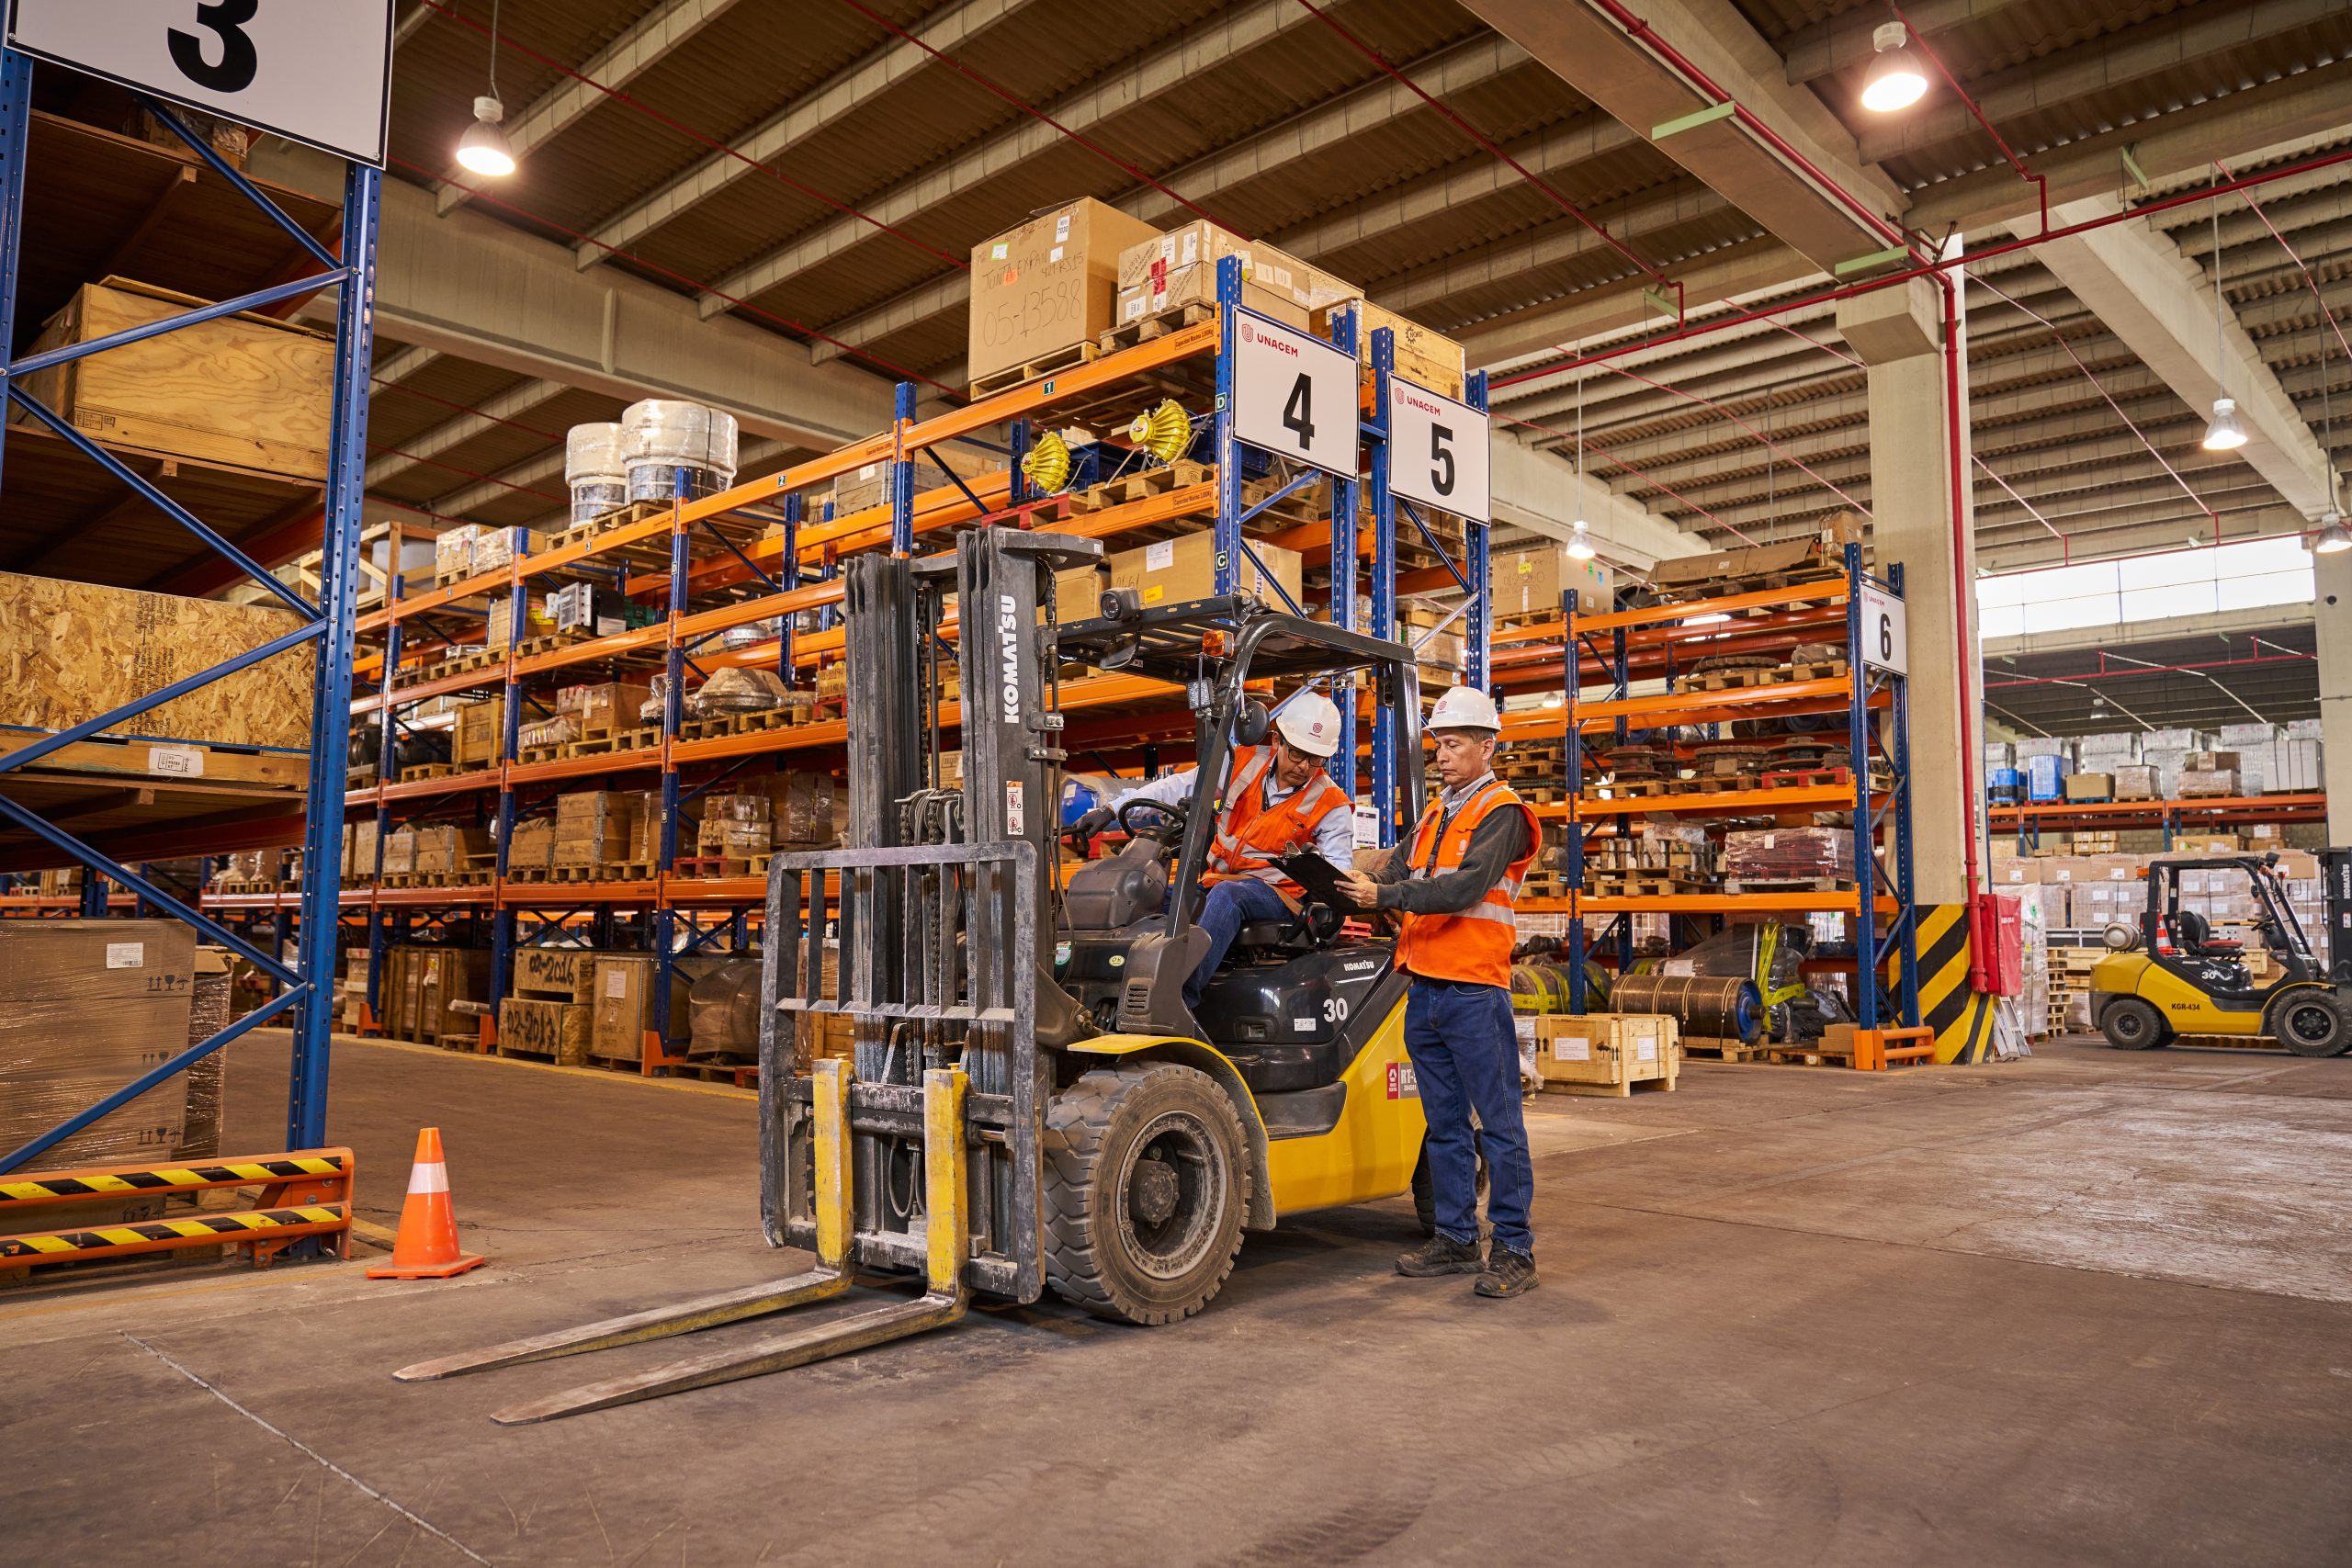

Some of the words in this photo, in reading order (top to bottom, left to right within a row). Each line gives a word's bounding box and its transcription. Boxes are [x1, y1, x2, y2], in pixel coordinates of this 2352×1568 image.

[167, 0, 258, 93] 3
[983, 279, 1081, 347] 05-13588
[1257, 333, 1298, 357] UNACEM
[1217, 397, 1225, 409] D
[1283, 372, 1315, 451] 4
[1407, 395, 1441, 416] UNACEM
[1430, 422, 1454, 497] 5
[1217, 555, 1226, 567] C
[1868, 595, 1884, 606] UNACEM
[1881, 613, 1891, 661] 6
[998, 595, 1019, 724] KOMATSU
[2341, 864, 2350, 898] KOMATSU
[529, 953, 574, 987] 02-2016
[1343, 960, 1374, 971] KOMATSU
[2201, 971, 2216, 979] 30
[1323, 998, 1348, 1022] 30
